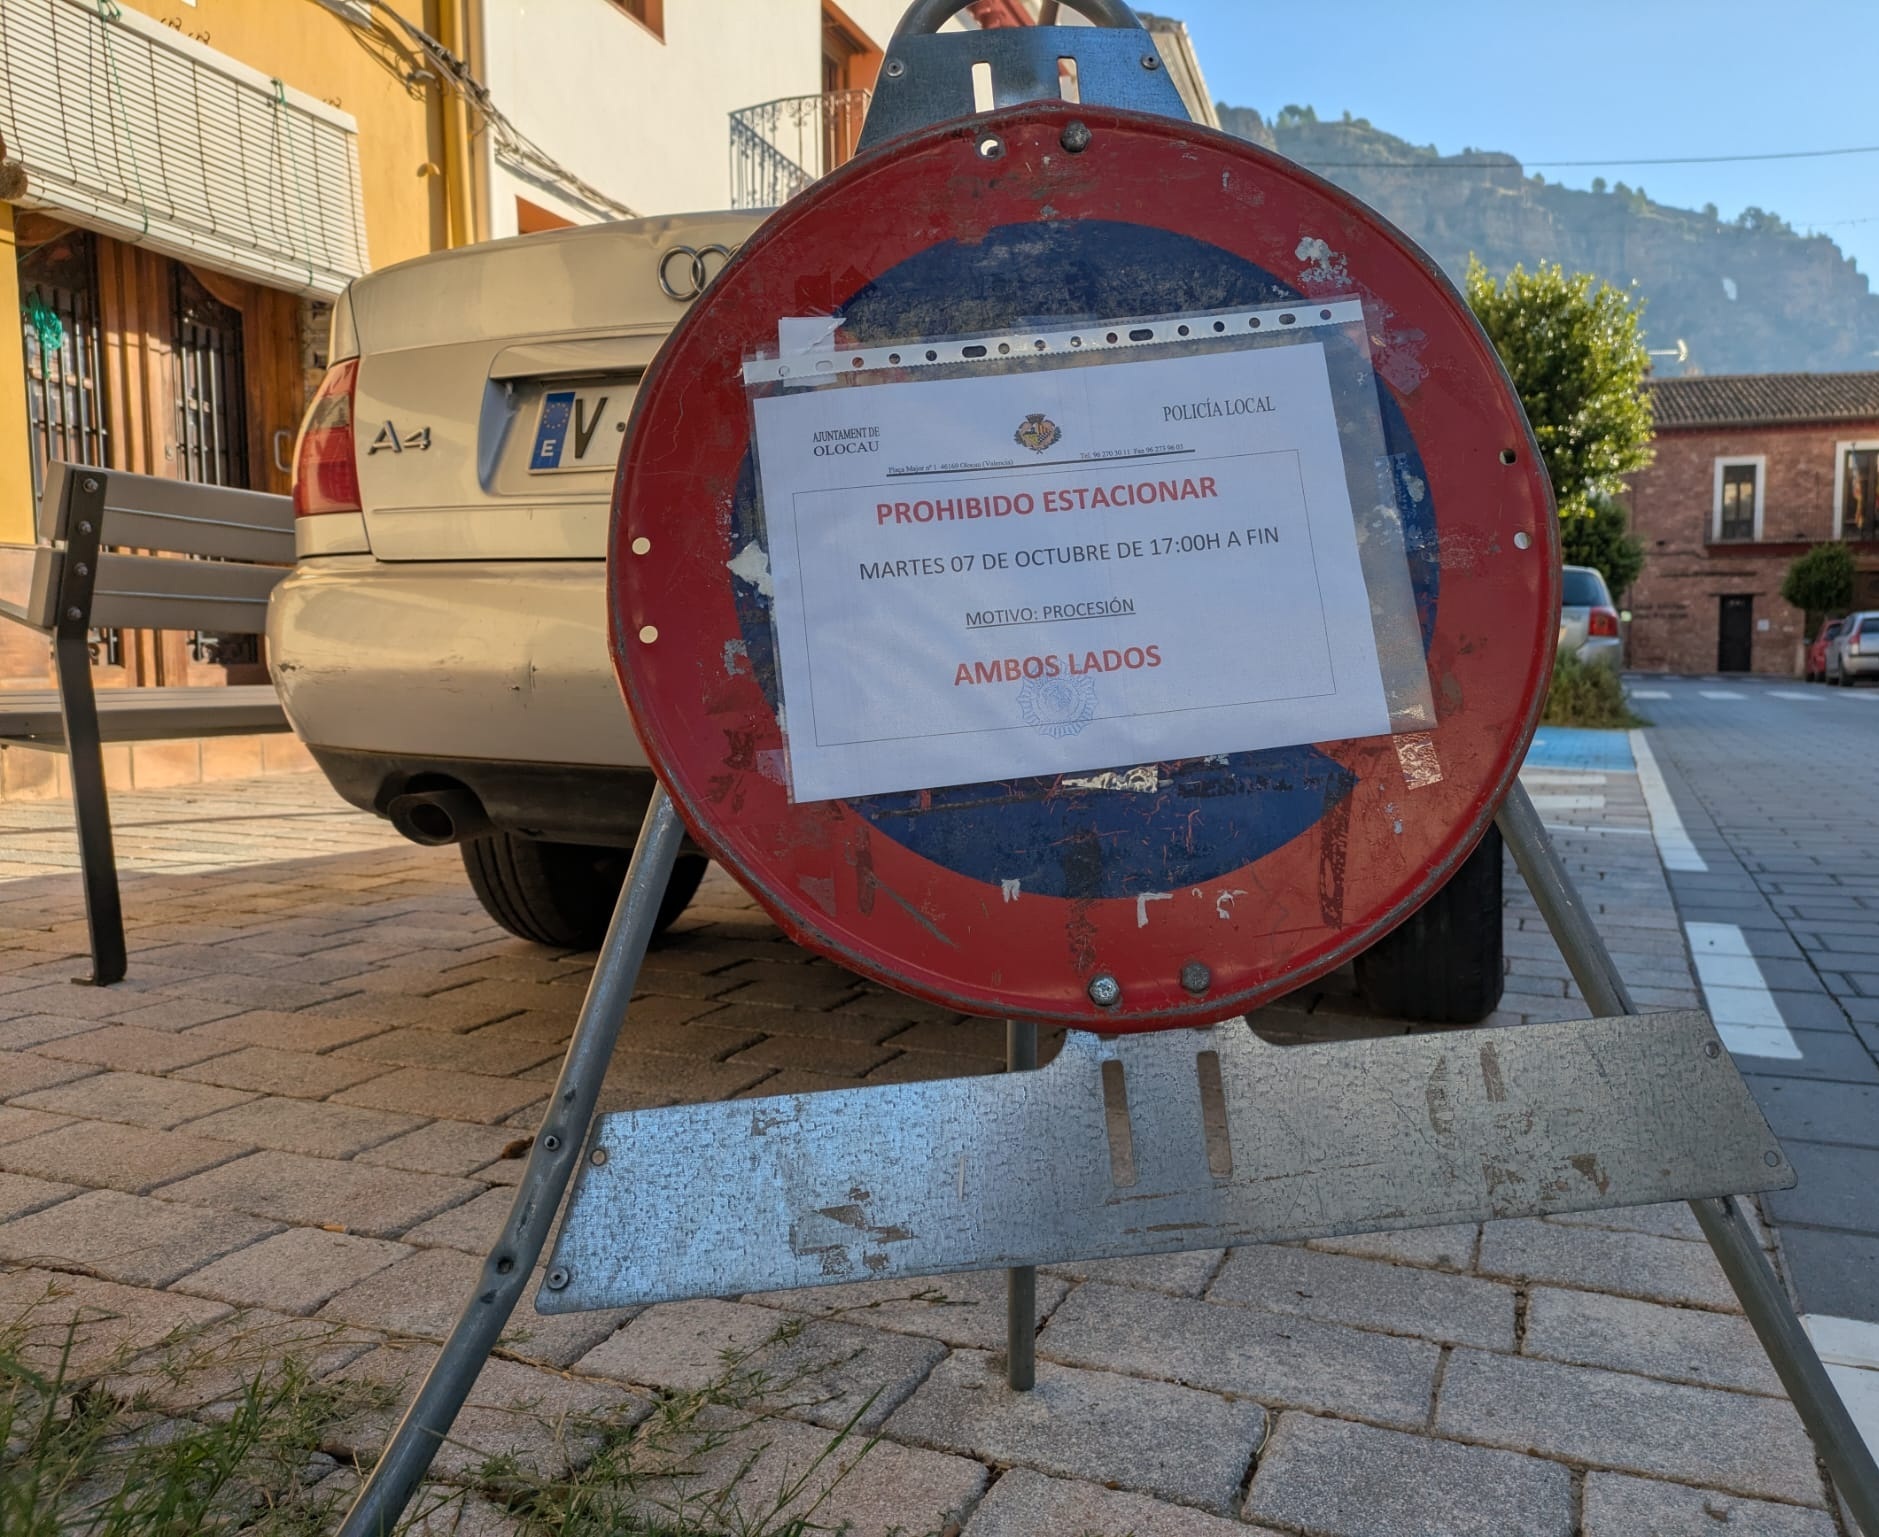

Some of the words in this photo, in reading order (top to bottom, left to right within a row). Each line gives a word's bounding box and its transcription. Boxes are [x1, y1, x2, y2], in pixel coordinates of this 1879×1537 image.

[1162, 397, 1222, 422] POLICÍA
[1224, 396, 1275, 416] LOCAL
[368, 420, 431, 455] A4
[541, 439, 556, 456] E
[813, 427, 867, 442] AJUNTAMENT
[869, 426, 880, 437] DE
[813, 440, 880, 457] OLOCAU
[876, 493, 1035, 526] PROHIBIDO
[1043, 476, 1218, 513] ESTACIONAR
[859, 557, 946, 580] MARTES
[951, 555, 975, 573] 07
[982, 552, 1009, 570] DE
[1014, 543, 1111, 567] OCTUBRE
[1117, 541, 1144, 559] DE
[1150, 532, 1220, 556] 17:00H
[1227, 531, 1242, 548] A
[1246, 527, 1279, 546] FIN
[965, 608, 1039, 626] MOTIVO:
[1043, 596, 1135, 619] PROCESIÓN
[954, 654, 1061, 686] AMBOS
[1068, 644, 1162, 676] LADOS
